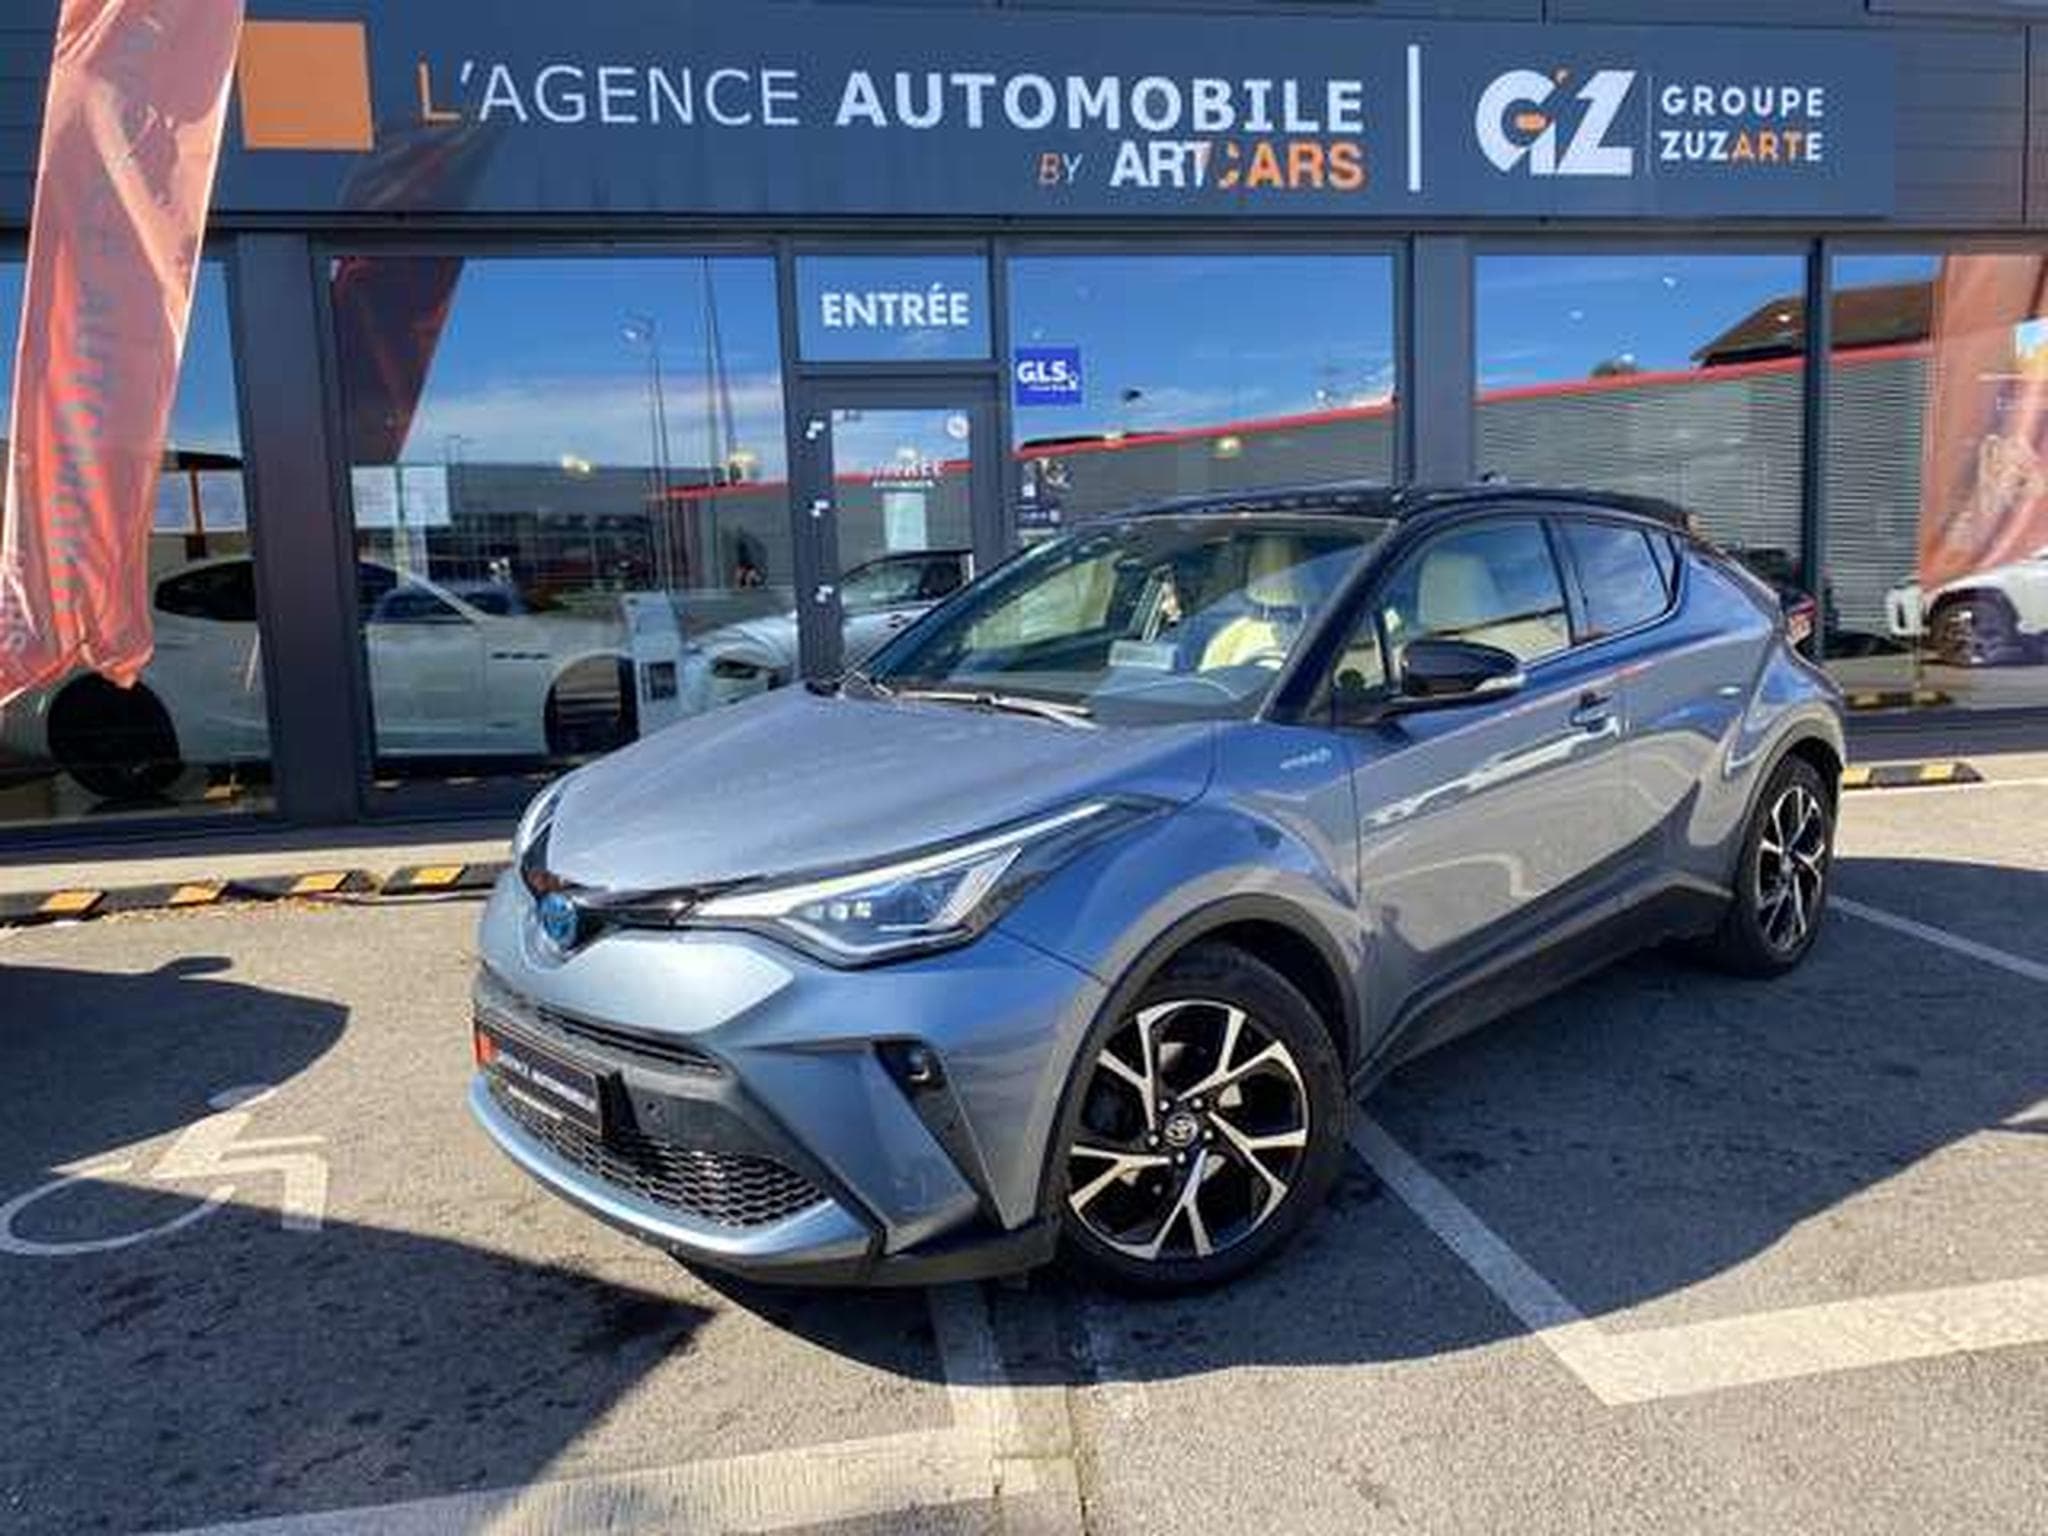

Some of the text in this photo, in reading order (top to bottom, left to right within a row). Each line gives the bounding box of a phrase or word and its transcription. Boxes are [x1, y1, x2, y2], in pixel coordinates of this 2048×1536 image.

[835, 70, 1365, 133] AUTOMOBILE
[1660, 84, 1824, 118] GROUPE
[1660, 129, 1824, 164] ZUZARTE
[1037, 153, 1082, 184] BY
[820, 283, 971, 327] ENTRÉE
[1016, 360, 1068, 385] GLS
